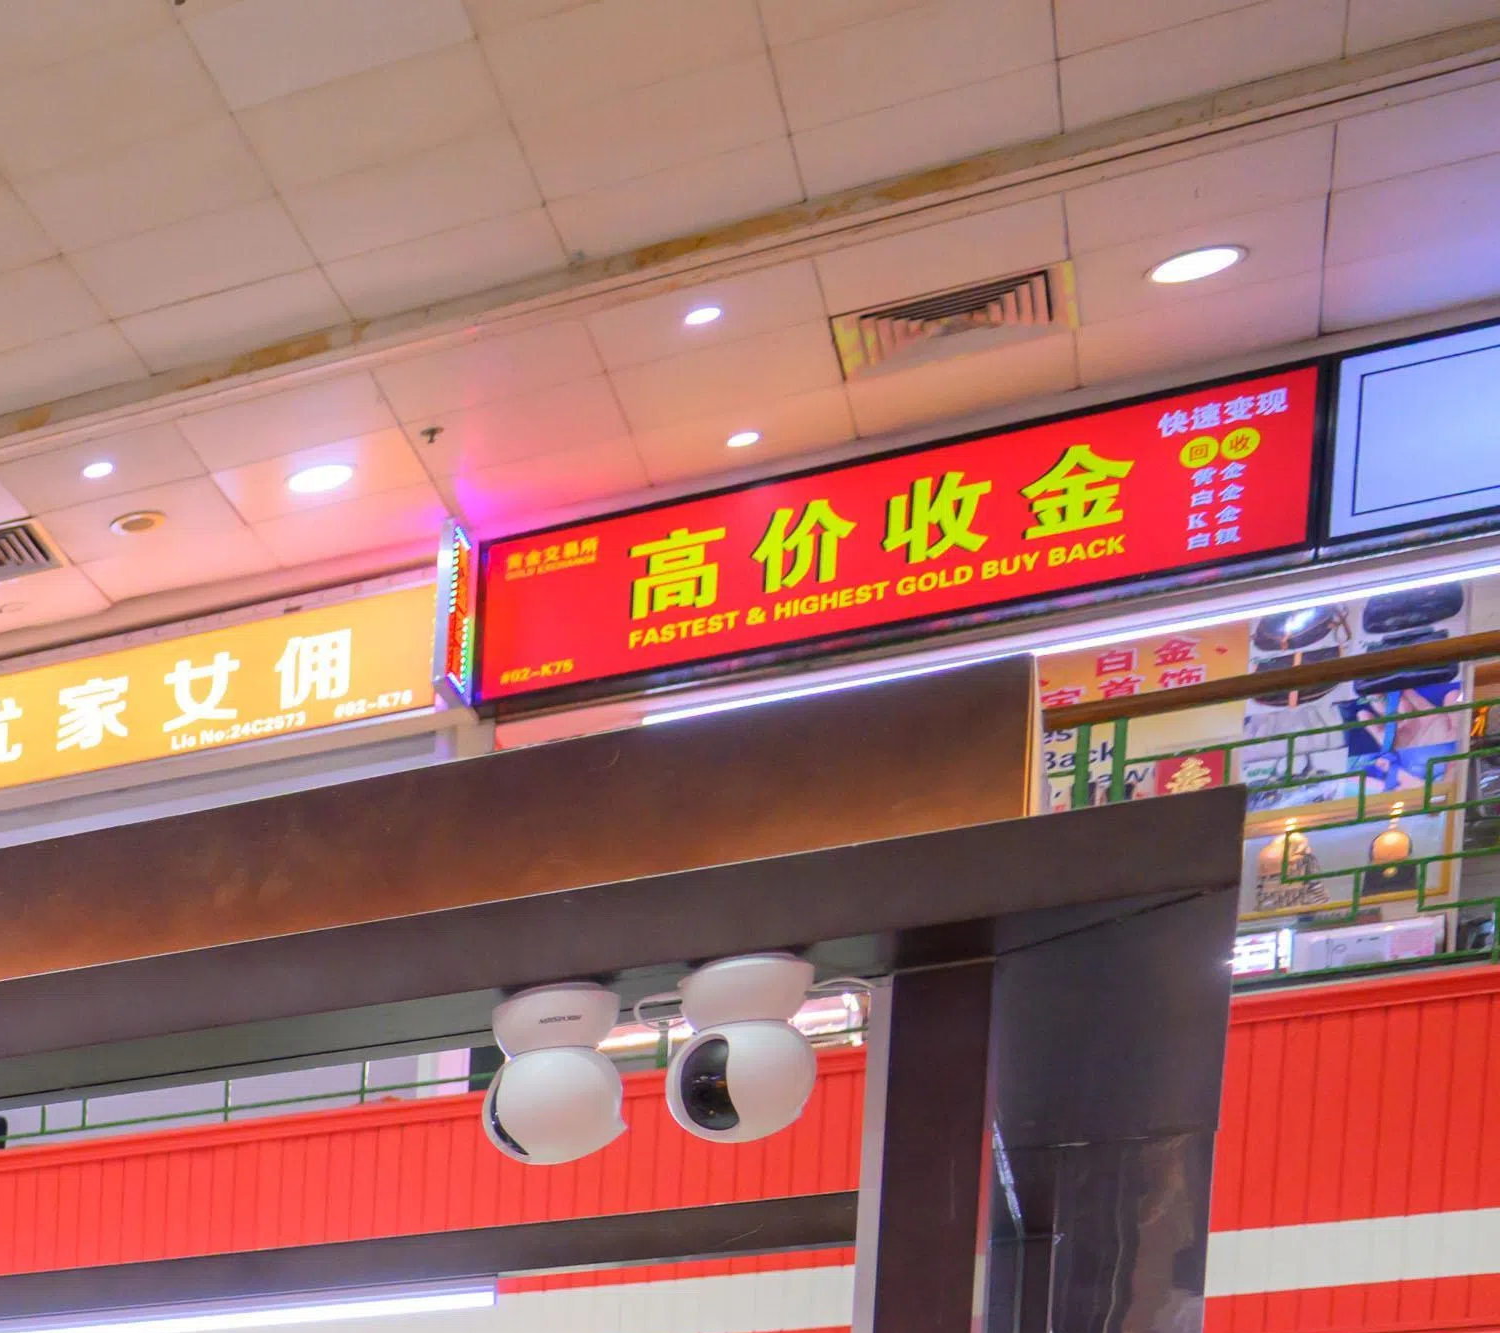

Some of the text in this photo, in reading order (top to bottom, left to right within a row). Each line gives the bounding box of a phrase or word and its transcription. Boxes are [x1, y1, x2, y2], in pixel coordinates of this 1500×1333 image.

[628, 535, 1125, 649] FASTEST & HIGHEST GOLD BUY BACK
[629, 444, 1135, 620] 高价收金
